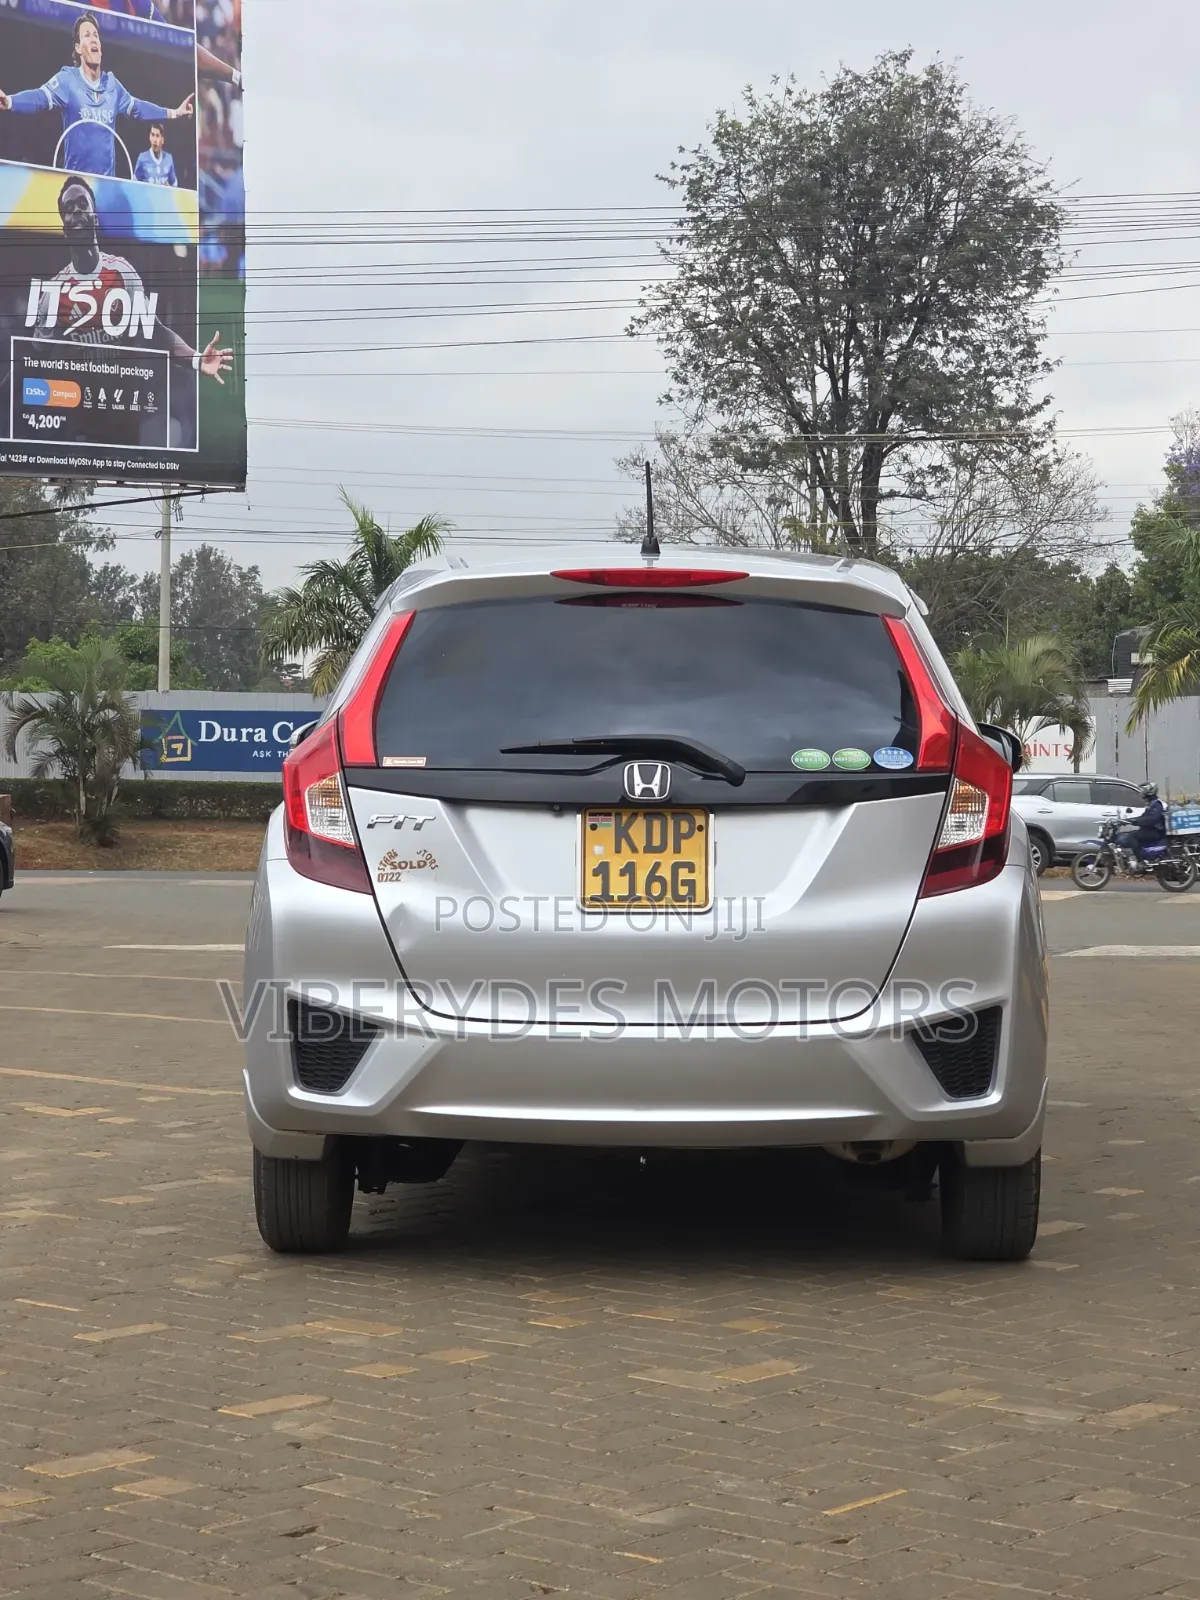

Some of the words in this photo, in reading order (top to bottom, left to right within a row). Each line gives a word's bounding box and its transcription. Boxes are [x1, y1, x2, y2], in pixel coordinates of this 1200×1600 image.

[101, 288, 158, 339] ON
[23, 356, 39, 368] The
[40, 360, 69, 370] world's
[70, 360, 88, 372] best
[89, 361, 119, 374] football
[120, 366, 154, 380] package
[52, 390, 77, 399] Compact
[28, 413, 60, 430] 4,200
[28, 456, 36, 464] or
[36, 455, 68, 465] Download
[69, 456, 92, 467] MyDStv
[92, 458, 105, 468] App
[106, 459, 112, 467] to
[113, 460, 127, 470] stay
[127, 460, 159, 469] Connected
[160, 461, 166, 469] to
[166, 462, 179, 470] DStv
[199, 720, 267, 743] Dura
[272, 721, 294, 743] C
[252, 750, 272, 758] ASK
[277, 750, 290, 758] TH
[366, 813, 436, 831] FIT
[614, 812, 696, 854] KDP
[389, 860, 427, 870] SOLD
[590, 860, 696, 902] 116G
